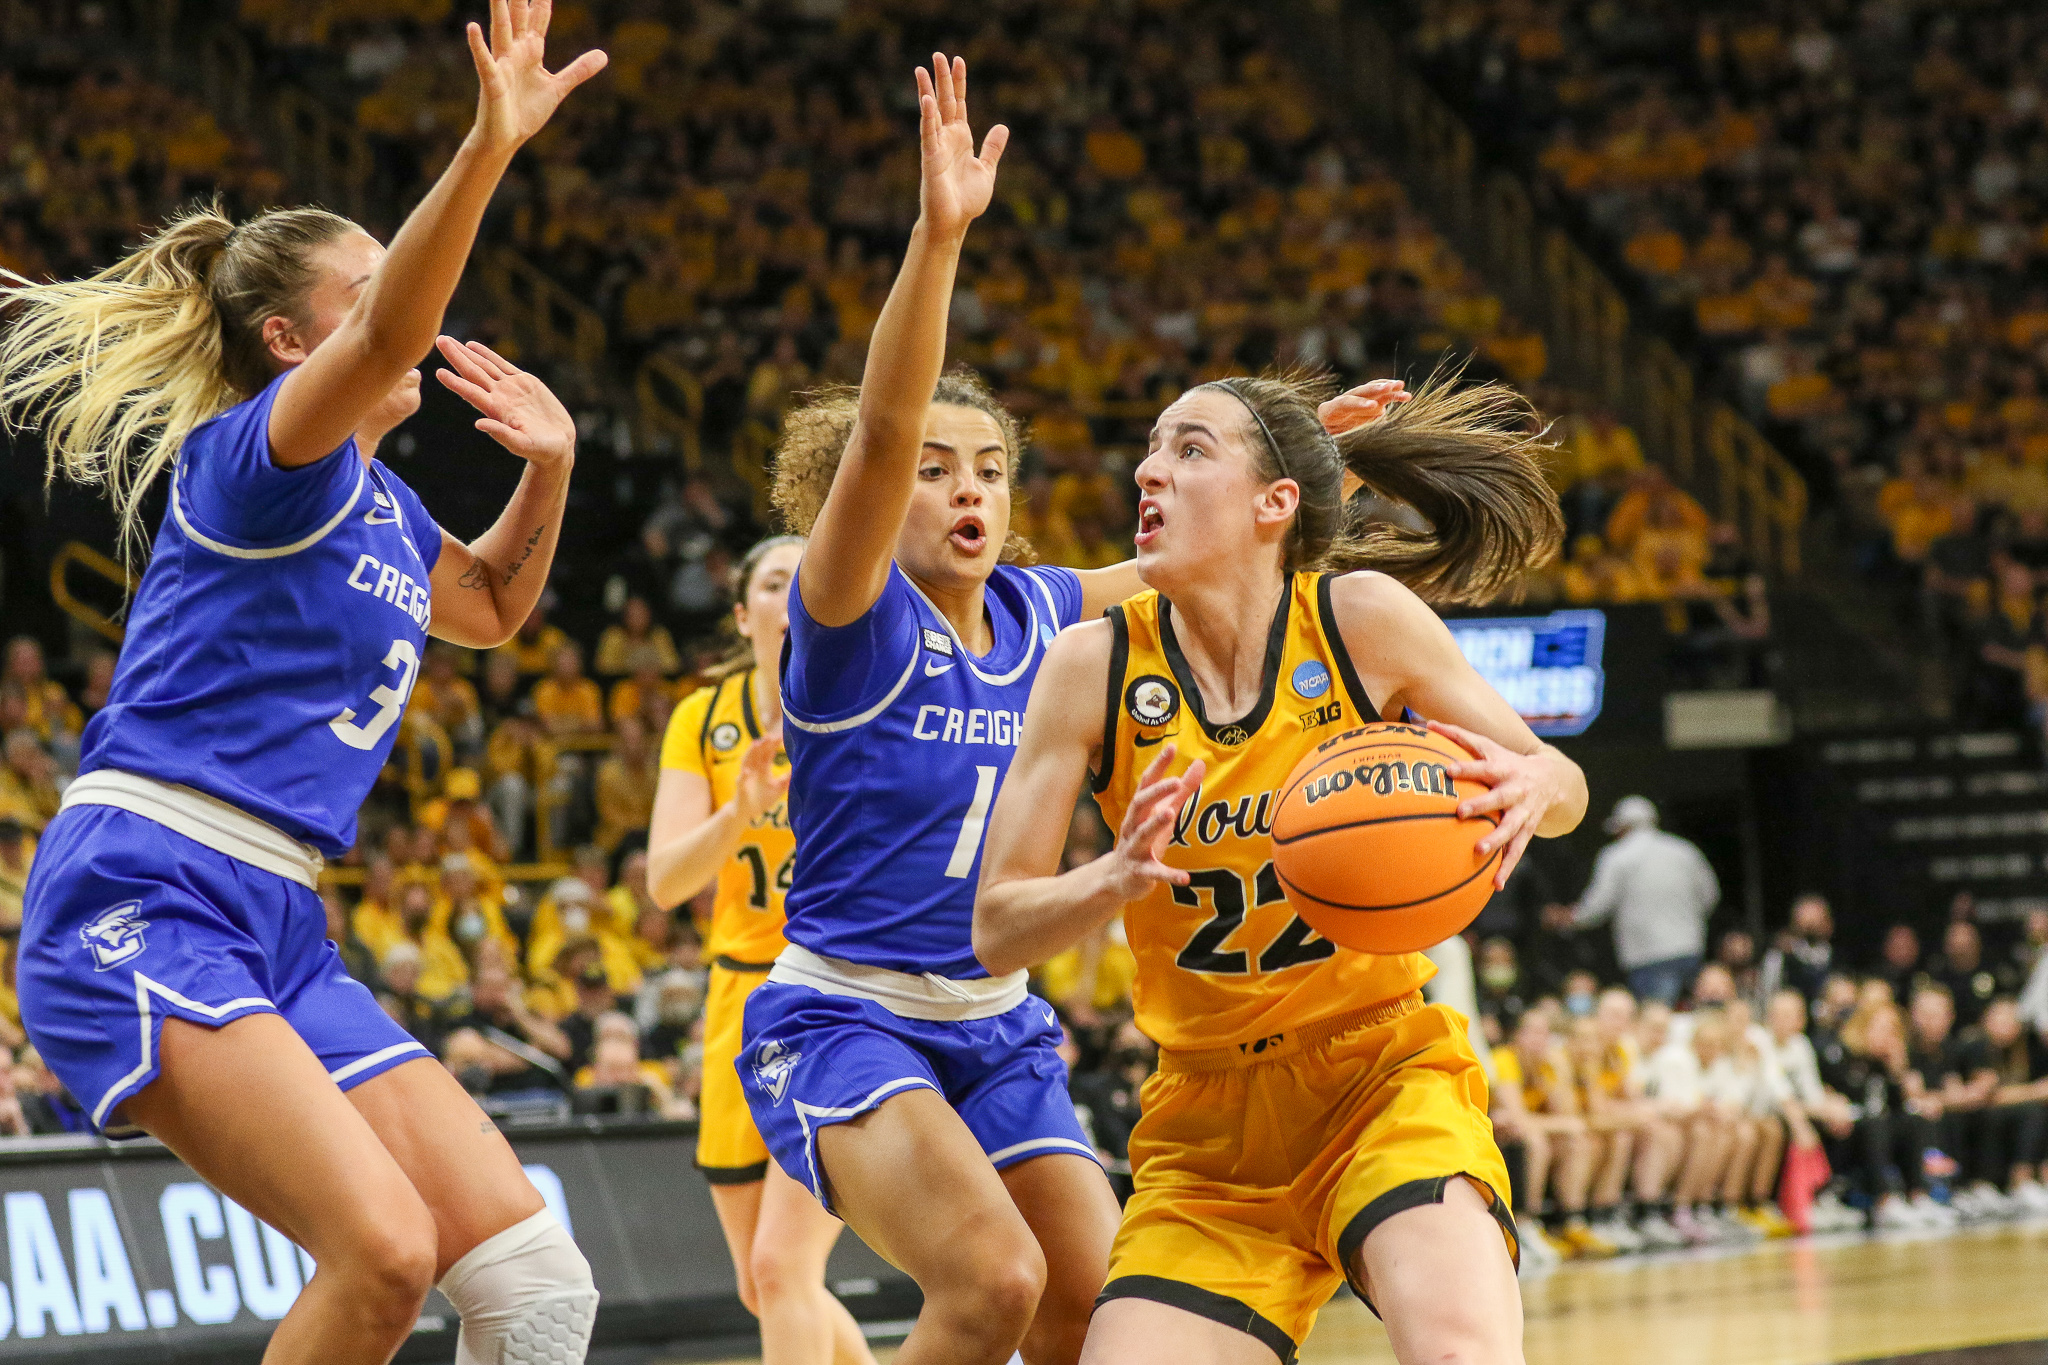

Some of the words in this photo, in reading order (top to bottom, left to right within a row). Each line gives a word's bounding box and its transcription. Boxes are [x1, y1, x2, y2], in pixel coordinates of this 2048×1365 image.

[328, 639, 421, 750] 3
[1299, 672, 1329, 691] NCAA
[944, 765, 998, 879] 1
[1303, 759, 1459, 807] Wilson
[1170, 858, 1339, 977] 22
[0, 1181, 317, 1342] AA.CO
